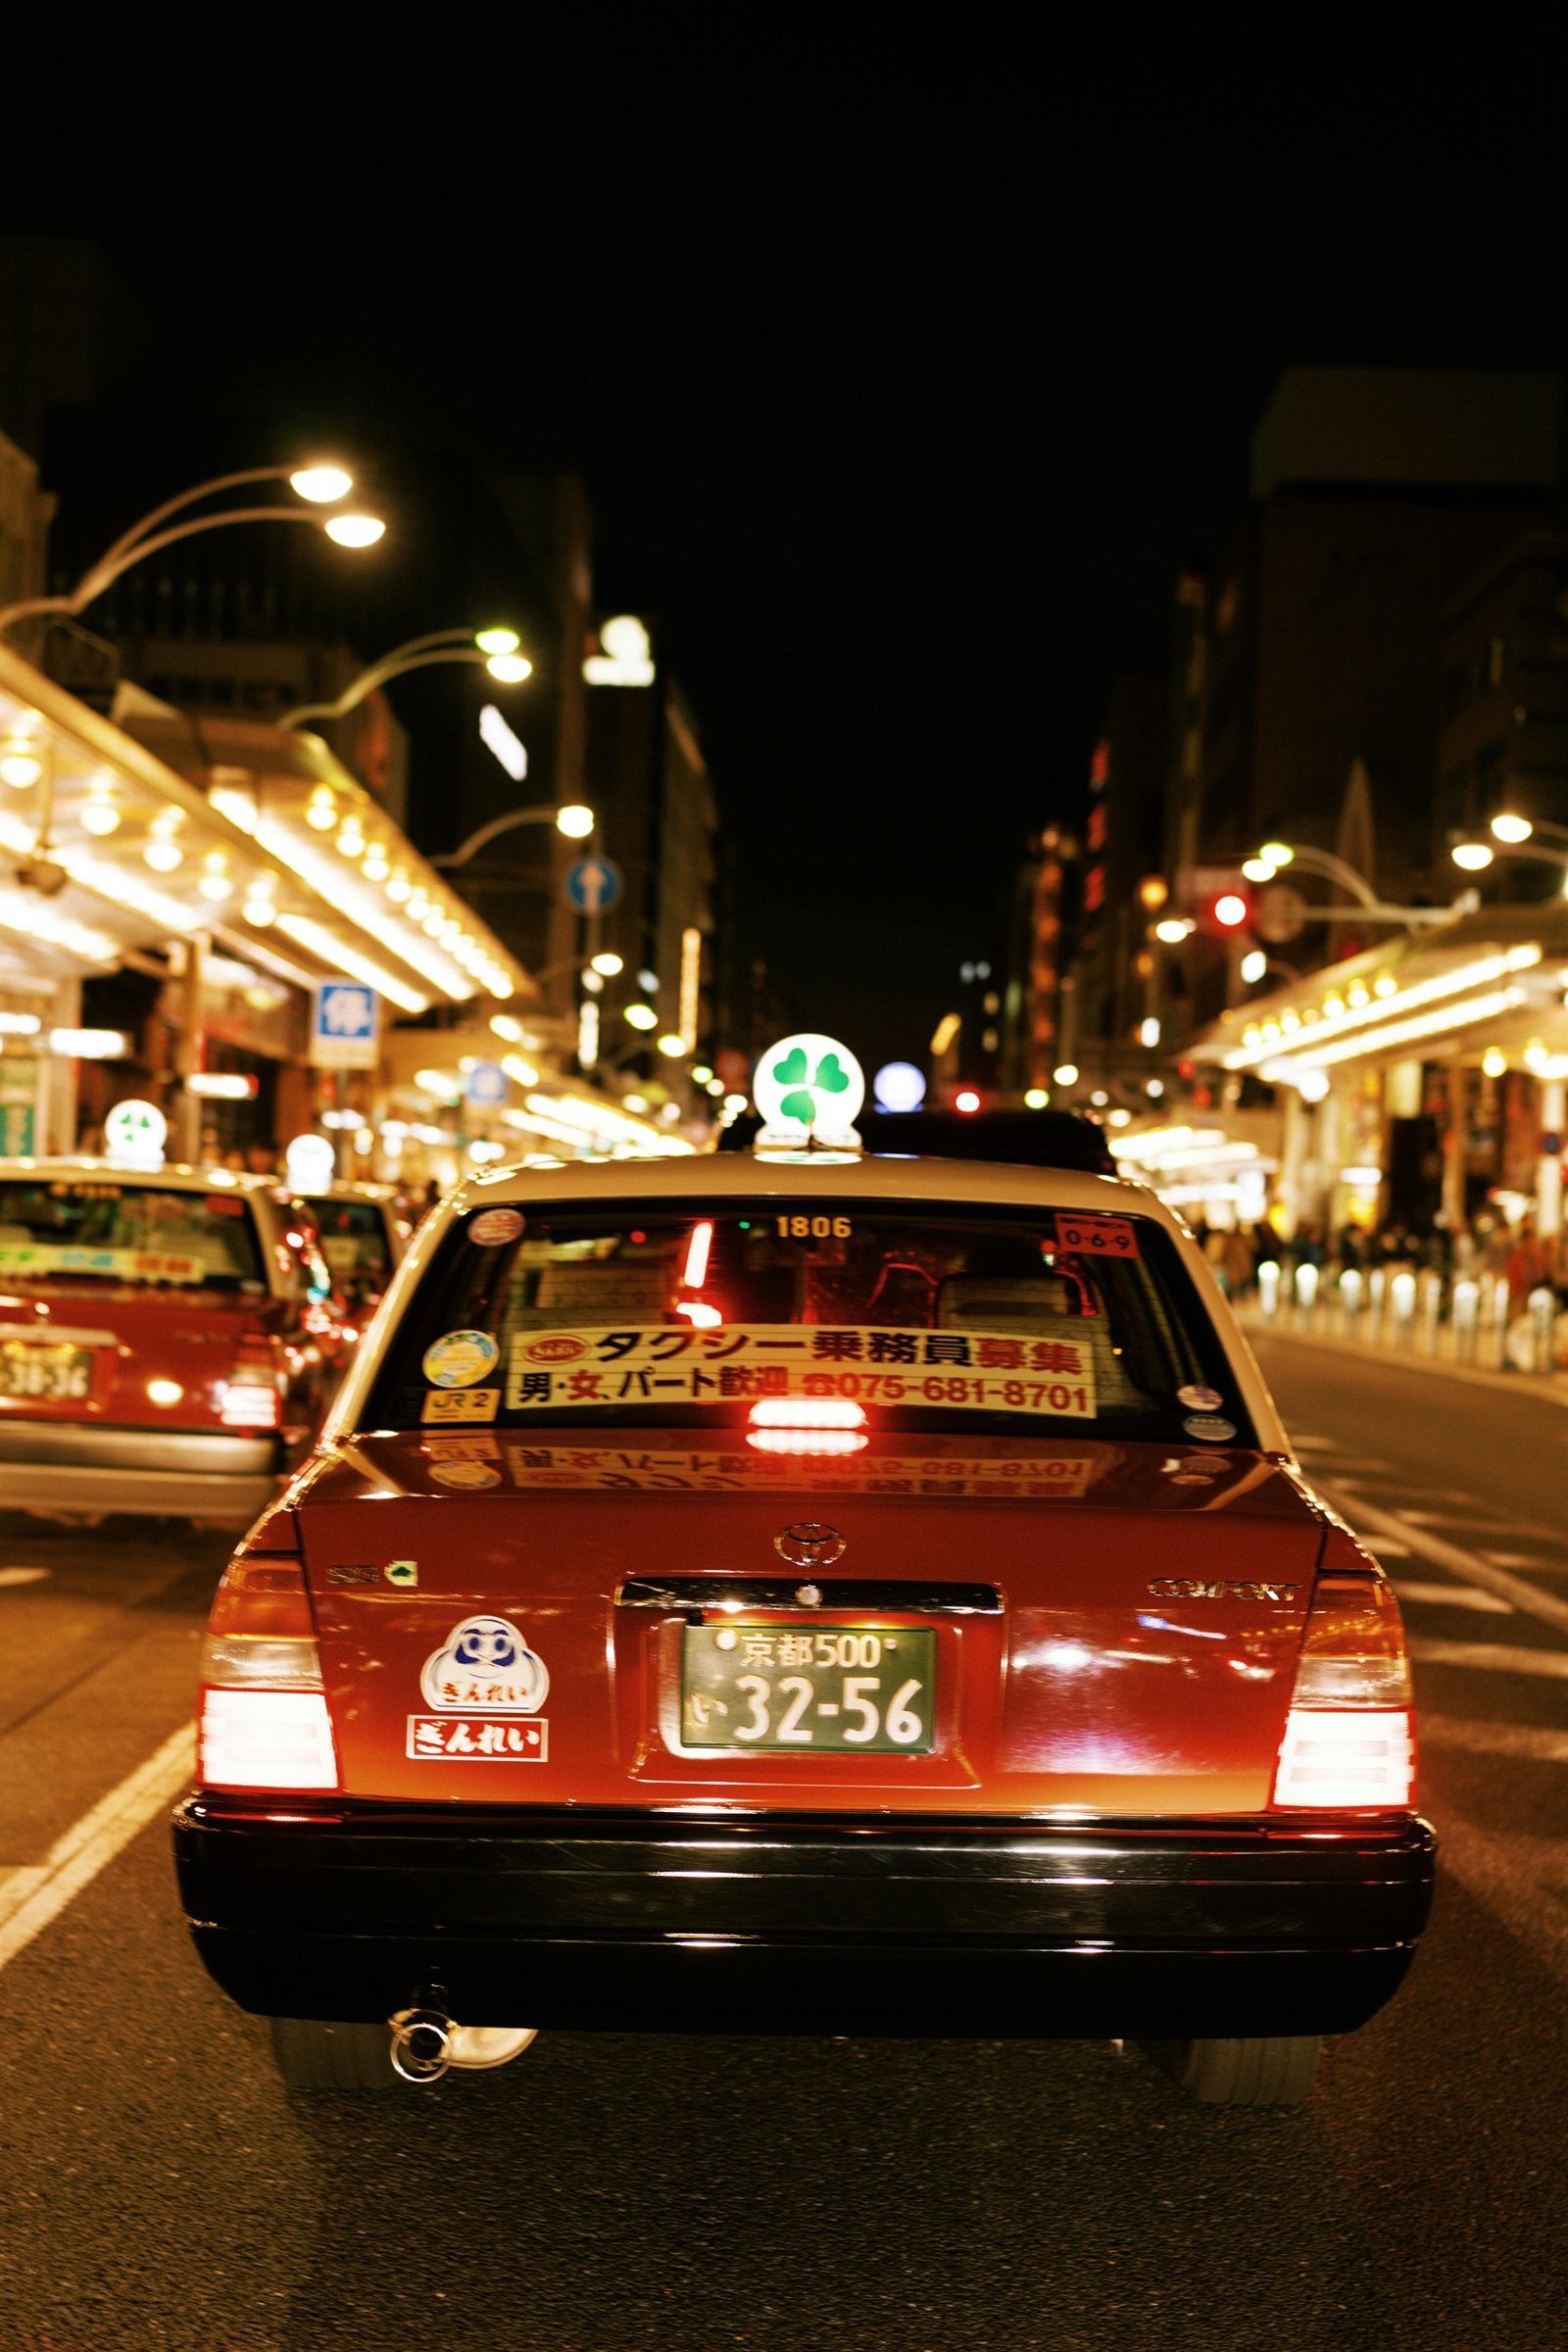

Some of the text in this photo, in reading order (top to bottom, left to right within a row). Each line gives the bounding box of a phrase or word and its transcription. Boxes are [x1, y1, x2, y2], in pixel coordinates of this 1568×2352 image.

[776, 1216, 852, 1238] 1806
[1065, 1229, 1130, 1250] 0-6-9
[472, 1392, 489, 1408] 2
[741, 1633, 881, 1668] 京都500
[442, 1680, 528, 1703] ぎんれい
[734, 1674, 924, 1744] 32-56
[415, 1721, 541, 1755] ぎんれい
